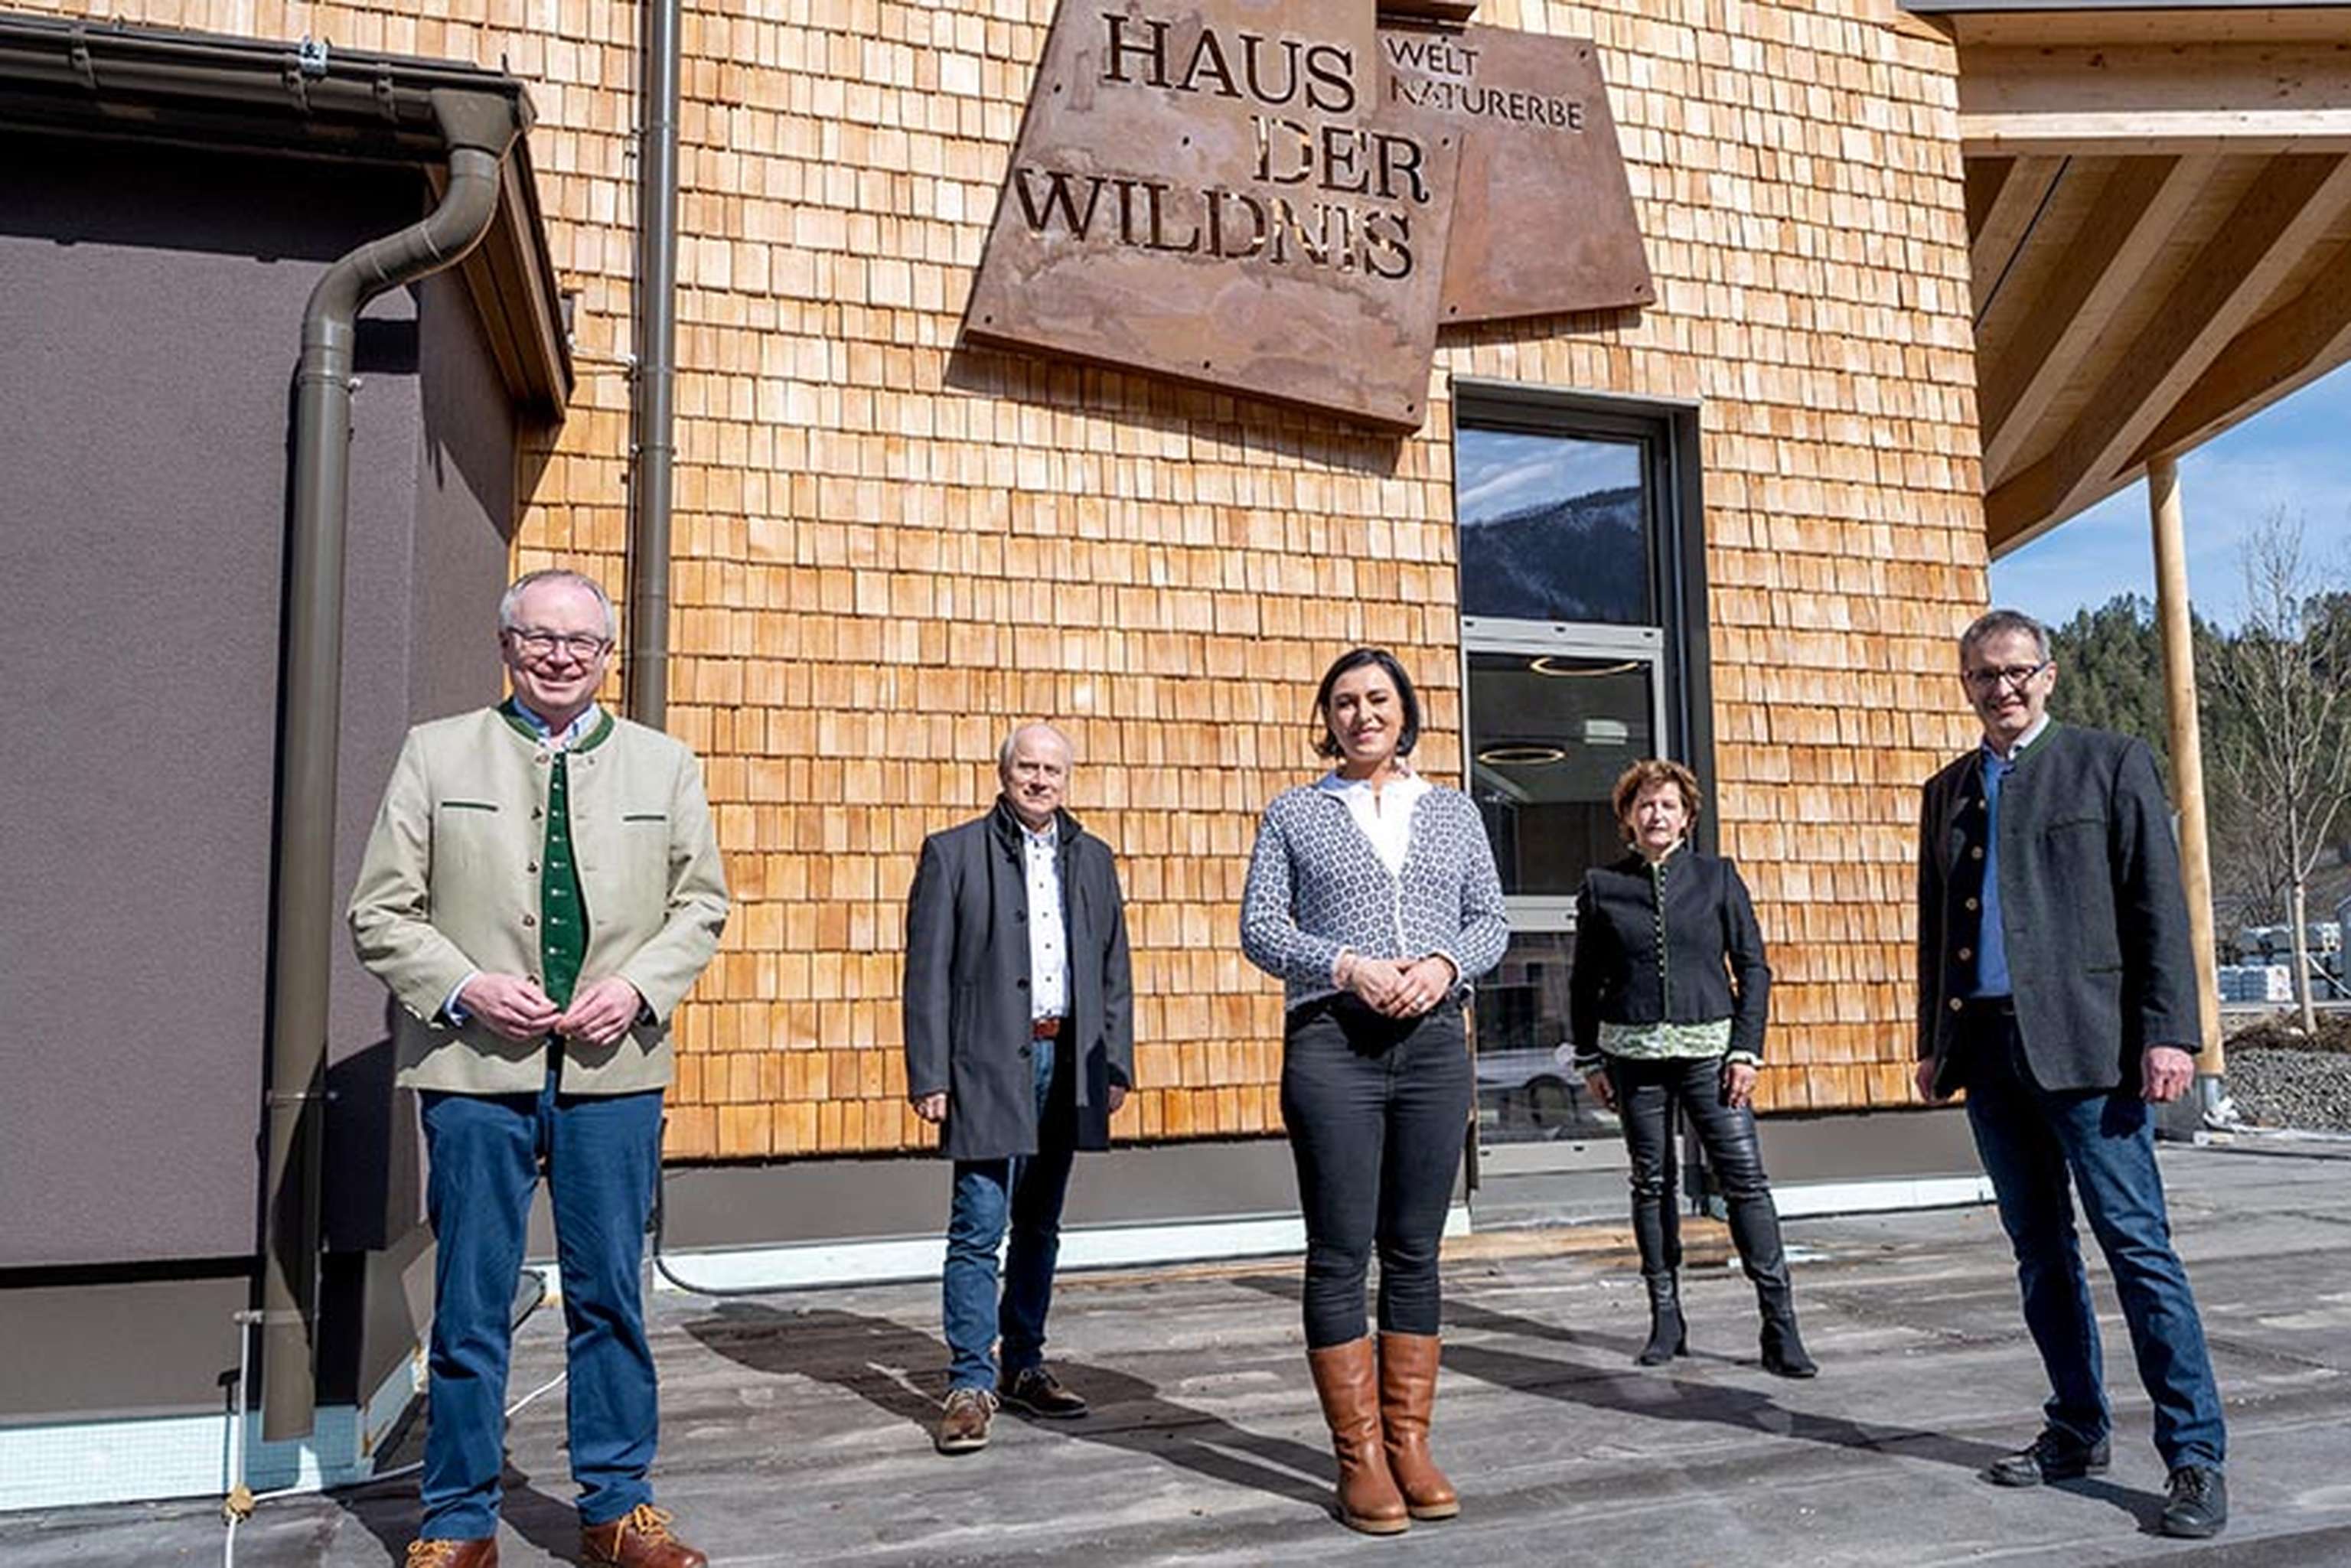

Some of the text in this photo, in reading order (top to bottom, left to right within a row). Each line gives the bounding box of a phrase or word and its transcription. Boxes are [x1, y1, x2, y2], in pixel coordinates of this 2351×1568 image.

[1102, 14, 1355, 112] HAUS
[1387, 37, 1479, 75] WELT
[1391, 75, 1583, 129] NATURERBE
[1253, 116, 1429, 204] DER
[1015, 166, 1414, 279] WILDNIS
